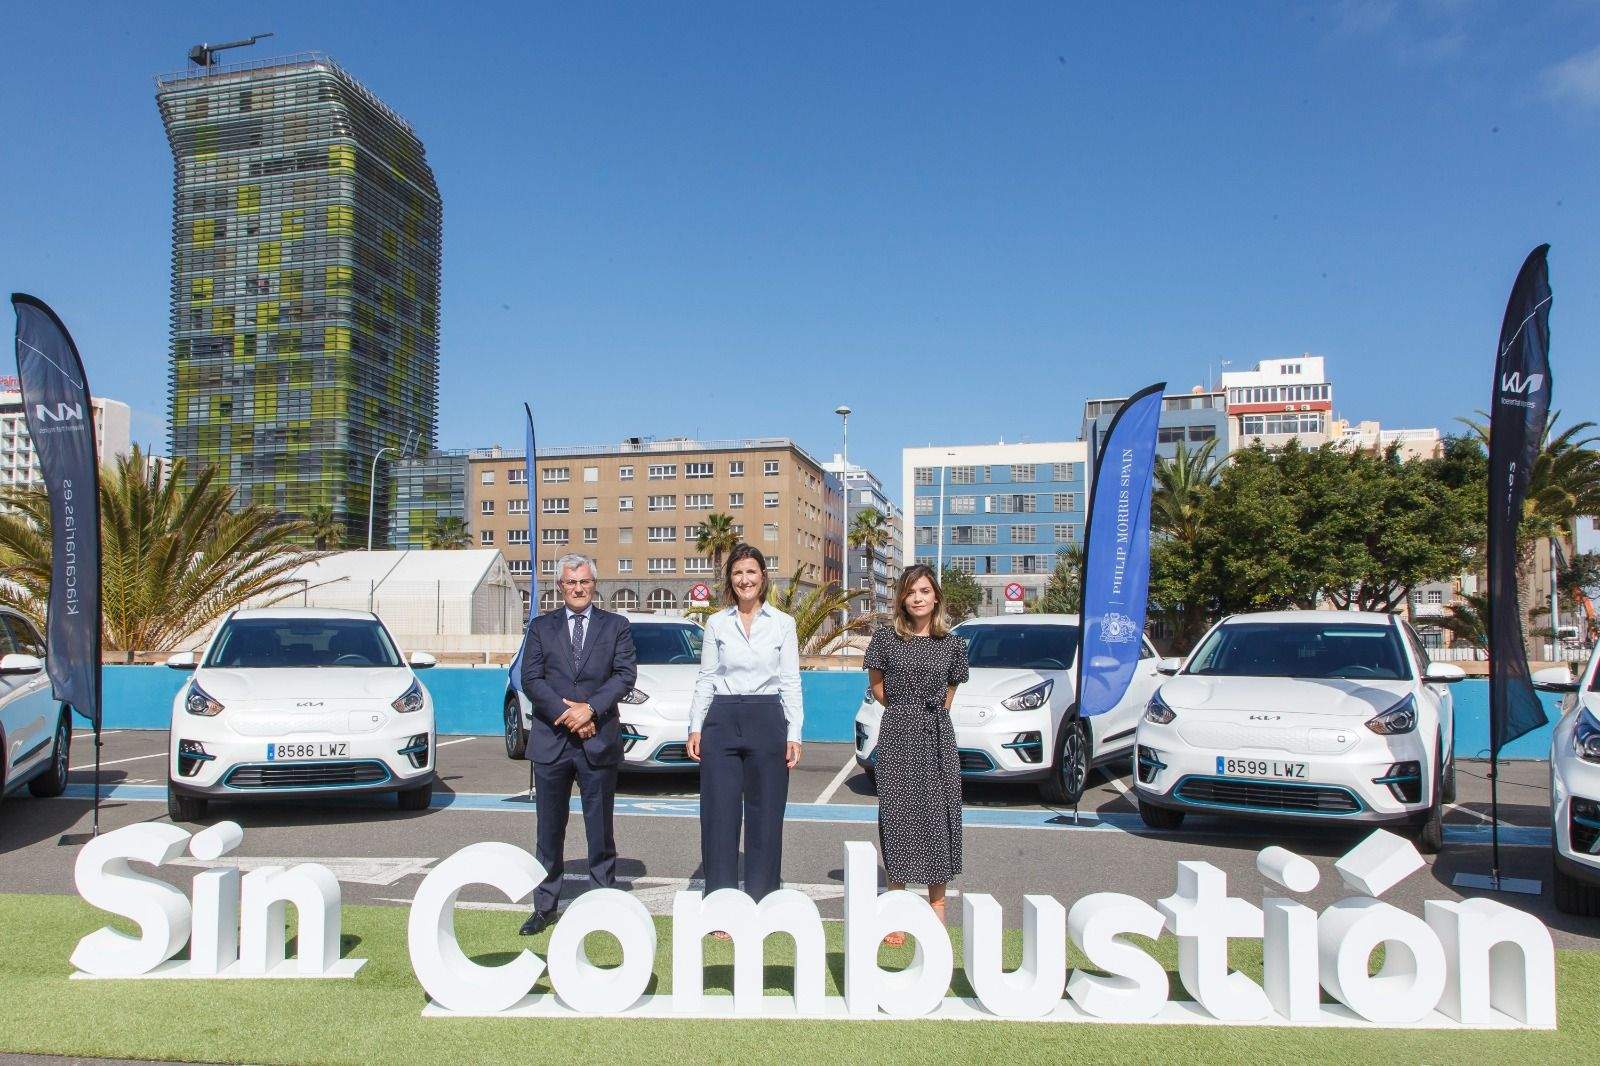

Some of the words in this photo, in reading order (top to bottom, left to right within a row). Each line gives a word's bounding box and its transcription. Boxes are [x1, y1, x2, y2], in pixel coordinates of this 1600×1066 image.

[1121, 448, 1133, 488] SPAIN
[1117, 490, 1129, 543] MORRIS
[1113, 547, 1126, 594] PHILIP
[278, 744, 314, 758] 8586
[319, 743, 347, 757] LWZ
[1227, 759, 1267, 775] 8599
[1273, 762, 1305, 778] LWZ
[69, 819, 342, 977] Sin
[408, 828, 1557, 1028] Combustión
